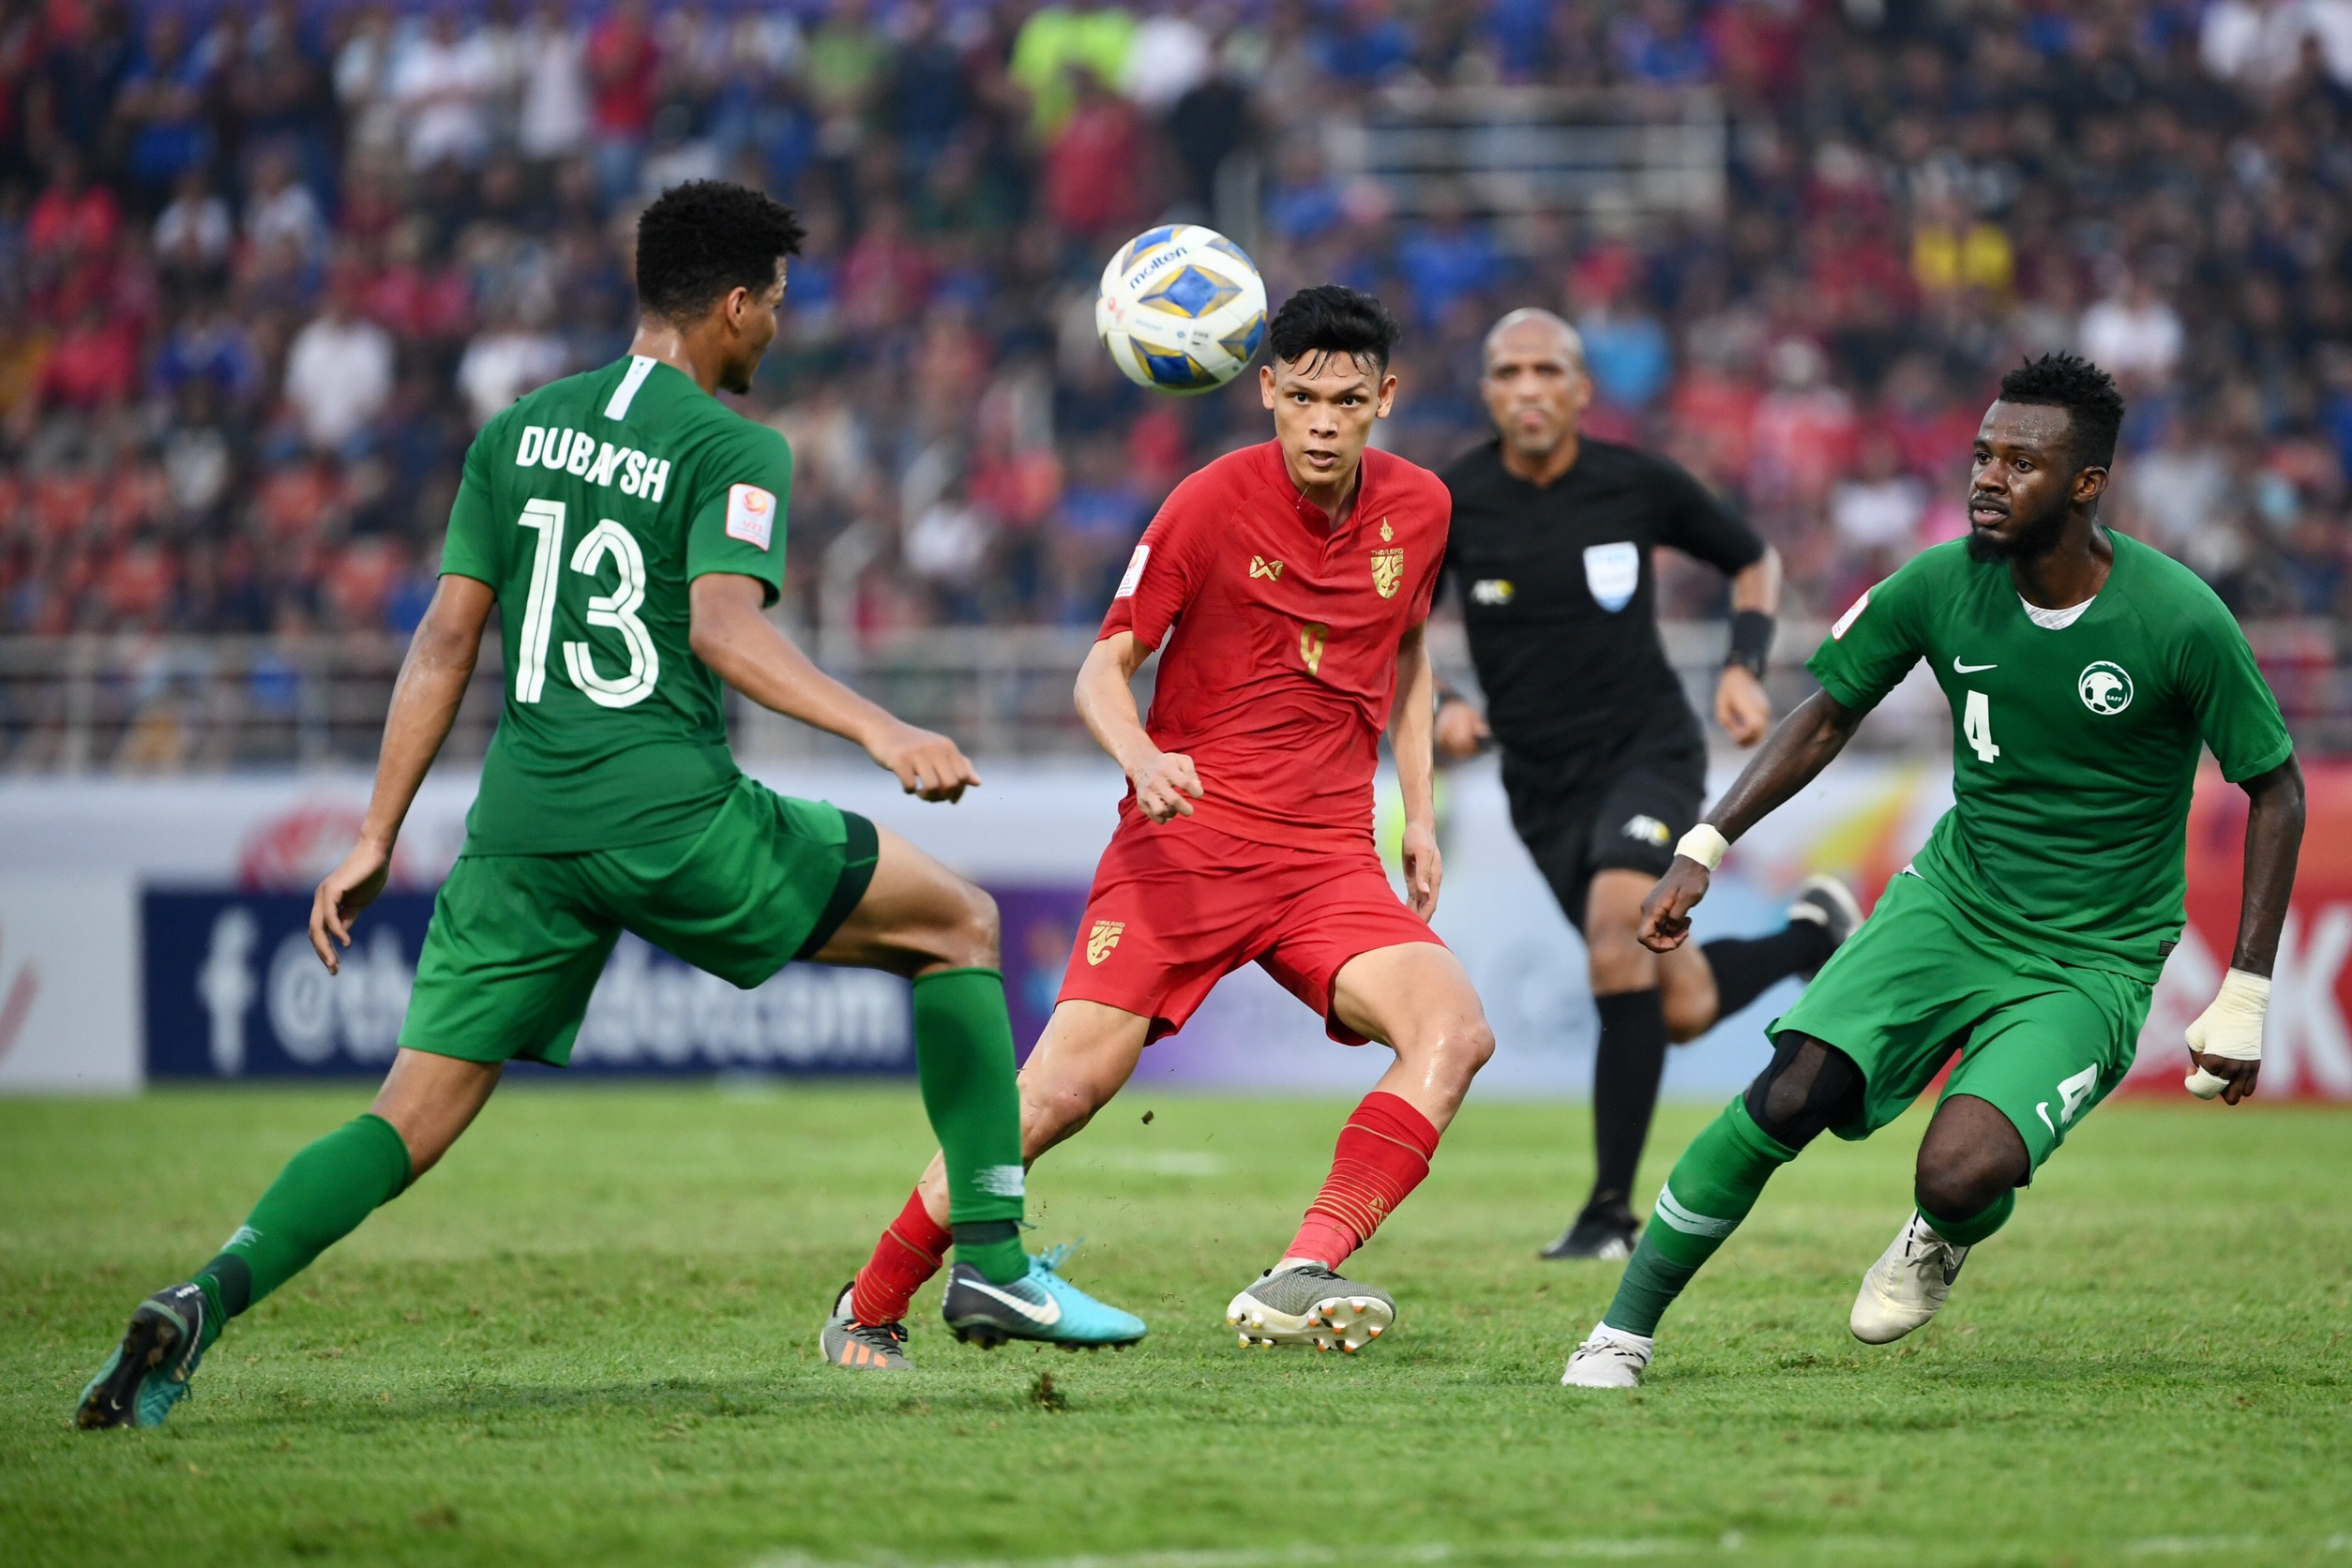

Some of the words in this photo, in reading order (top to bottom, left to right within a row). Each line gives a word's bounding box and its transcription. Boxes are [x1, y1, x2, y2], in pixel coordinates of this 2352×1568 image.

[1129, 246, 1188, 290] molten
[515, 425, 671, 504] DUBAYSH
[1370, 548, 1404, 557] THAILAND
[515, 497, 660, 709] 13
[1299, 622, 1329, 677] 9
[1963, 689, 2000, 764] 4
[2105, 694, 2123, 702] SAFF
[2056, 1061, 2099, 1125] 4
